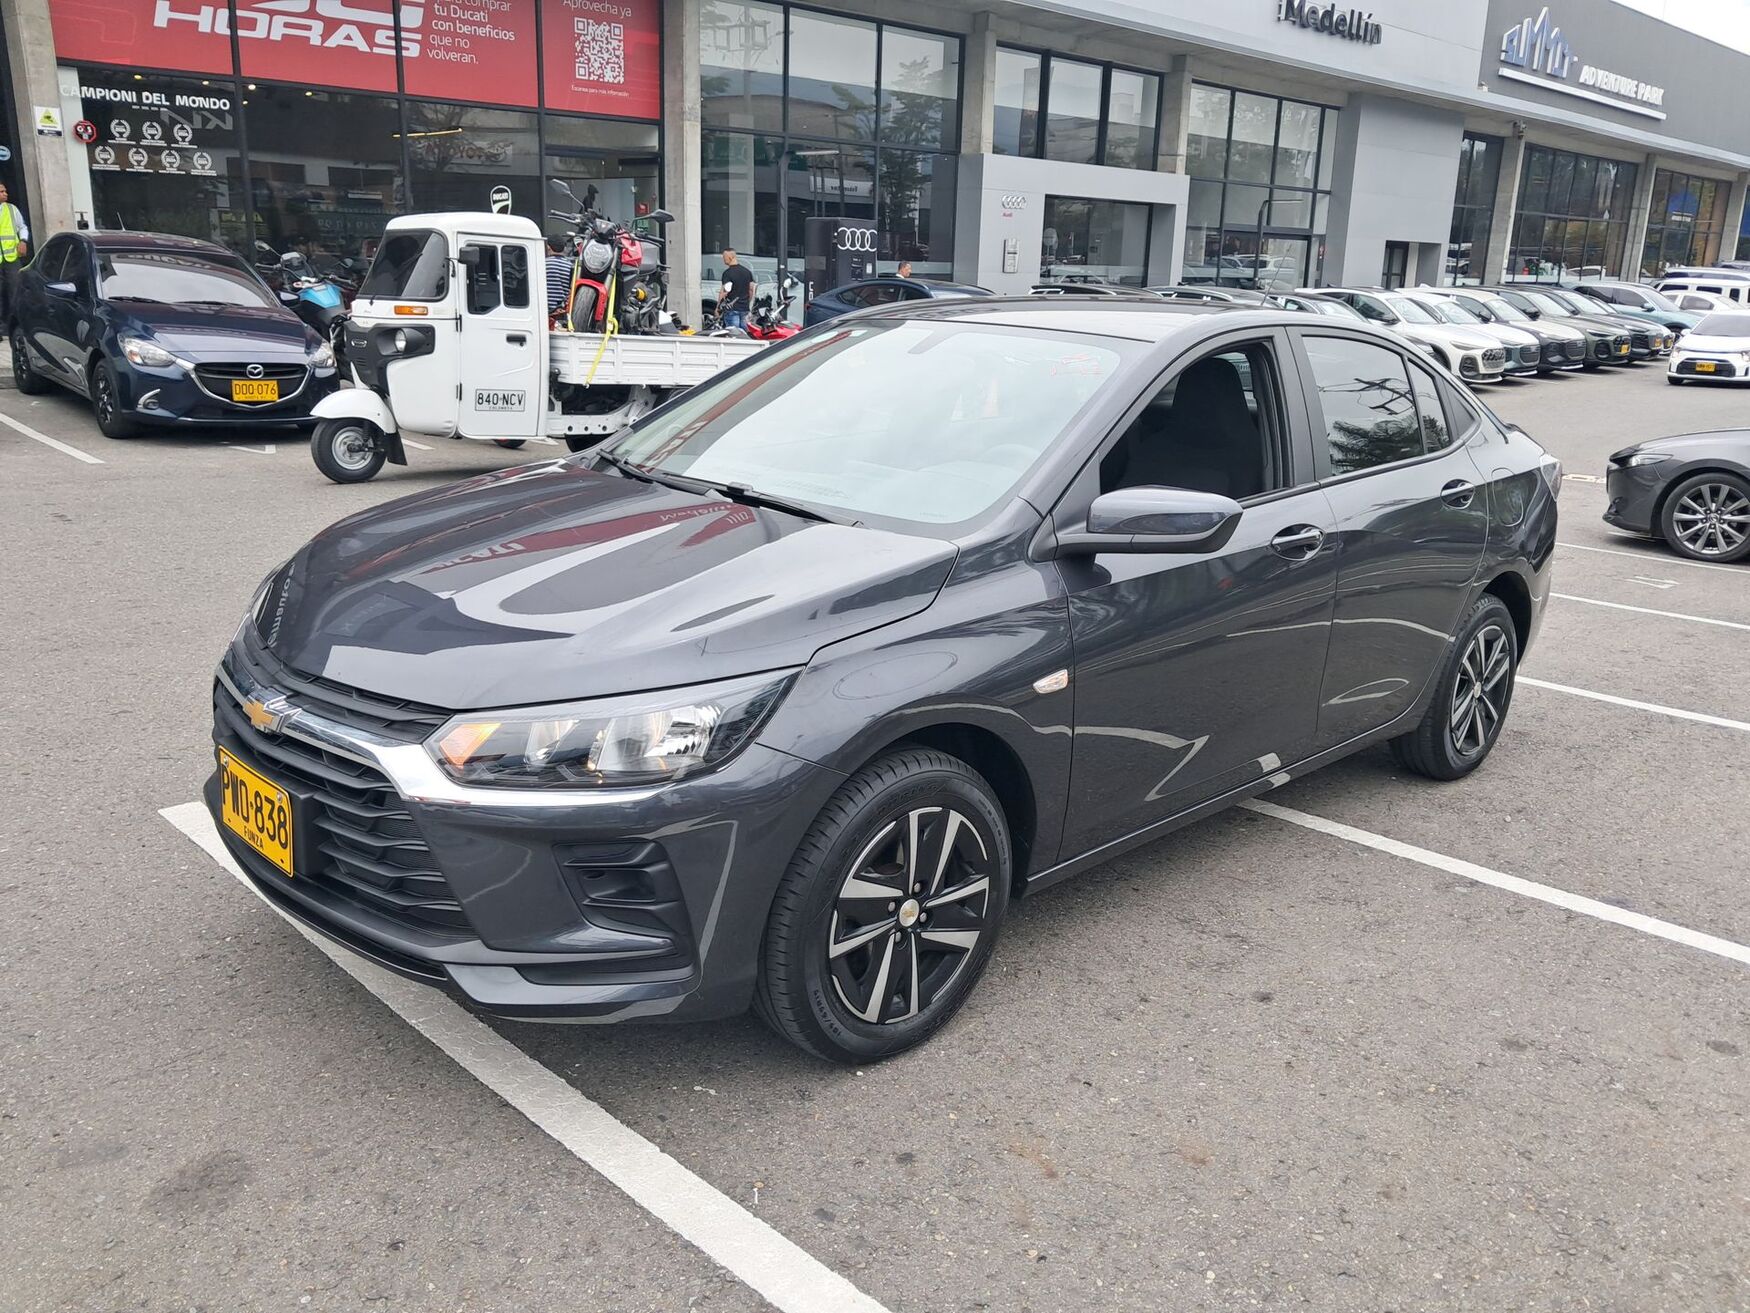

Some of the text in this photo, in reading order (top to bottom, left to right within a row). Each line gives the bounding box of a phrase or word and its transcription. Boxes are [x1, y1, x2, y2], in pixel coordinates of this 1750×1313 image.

[434, 3, 447, 16] tu
[450, 5, 488, 22] Ducati
[619, 7, 632, 19] ya
[153, 0, 422, 57] HORAS
[432, 19, 515, 41] con beneficios
[429, 34, 470, 48] que no
[427, 46, 479, 64] volveran.
[1579, 65, 1665, 105] ADVENTURE PARK
[61, 86, 231, 111] CAMPIONI DEL MONDO
[243, 824, 264, 851] FUNZA
